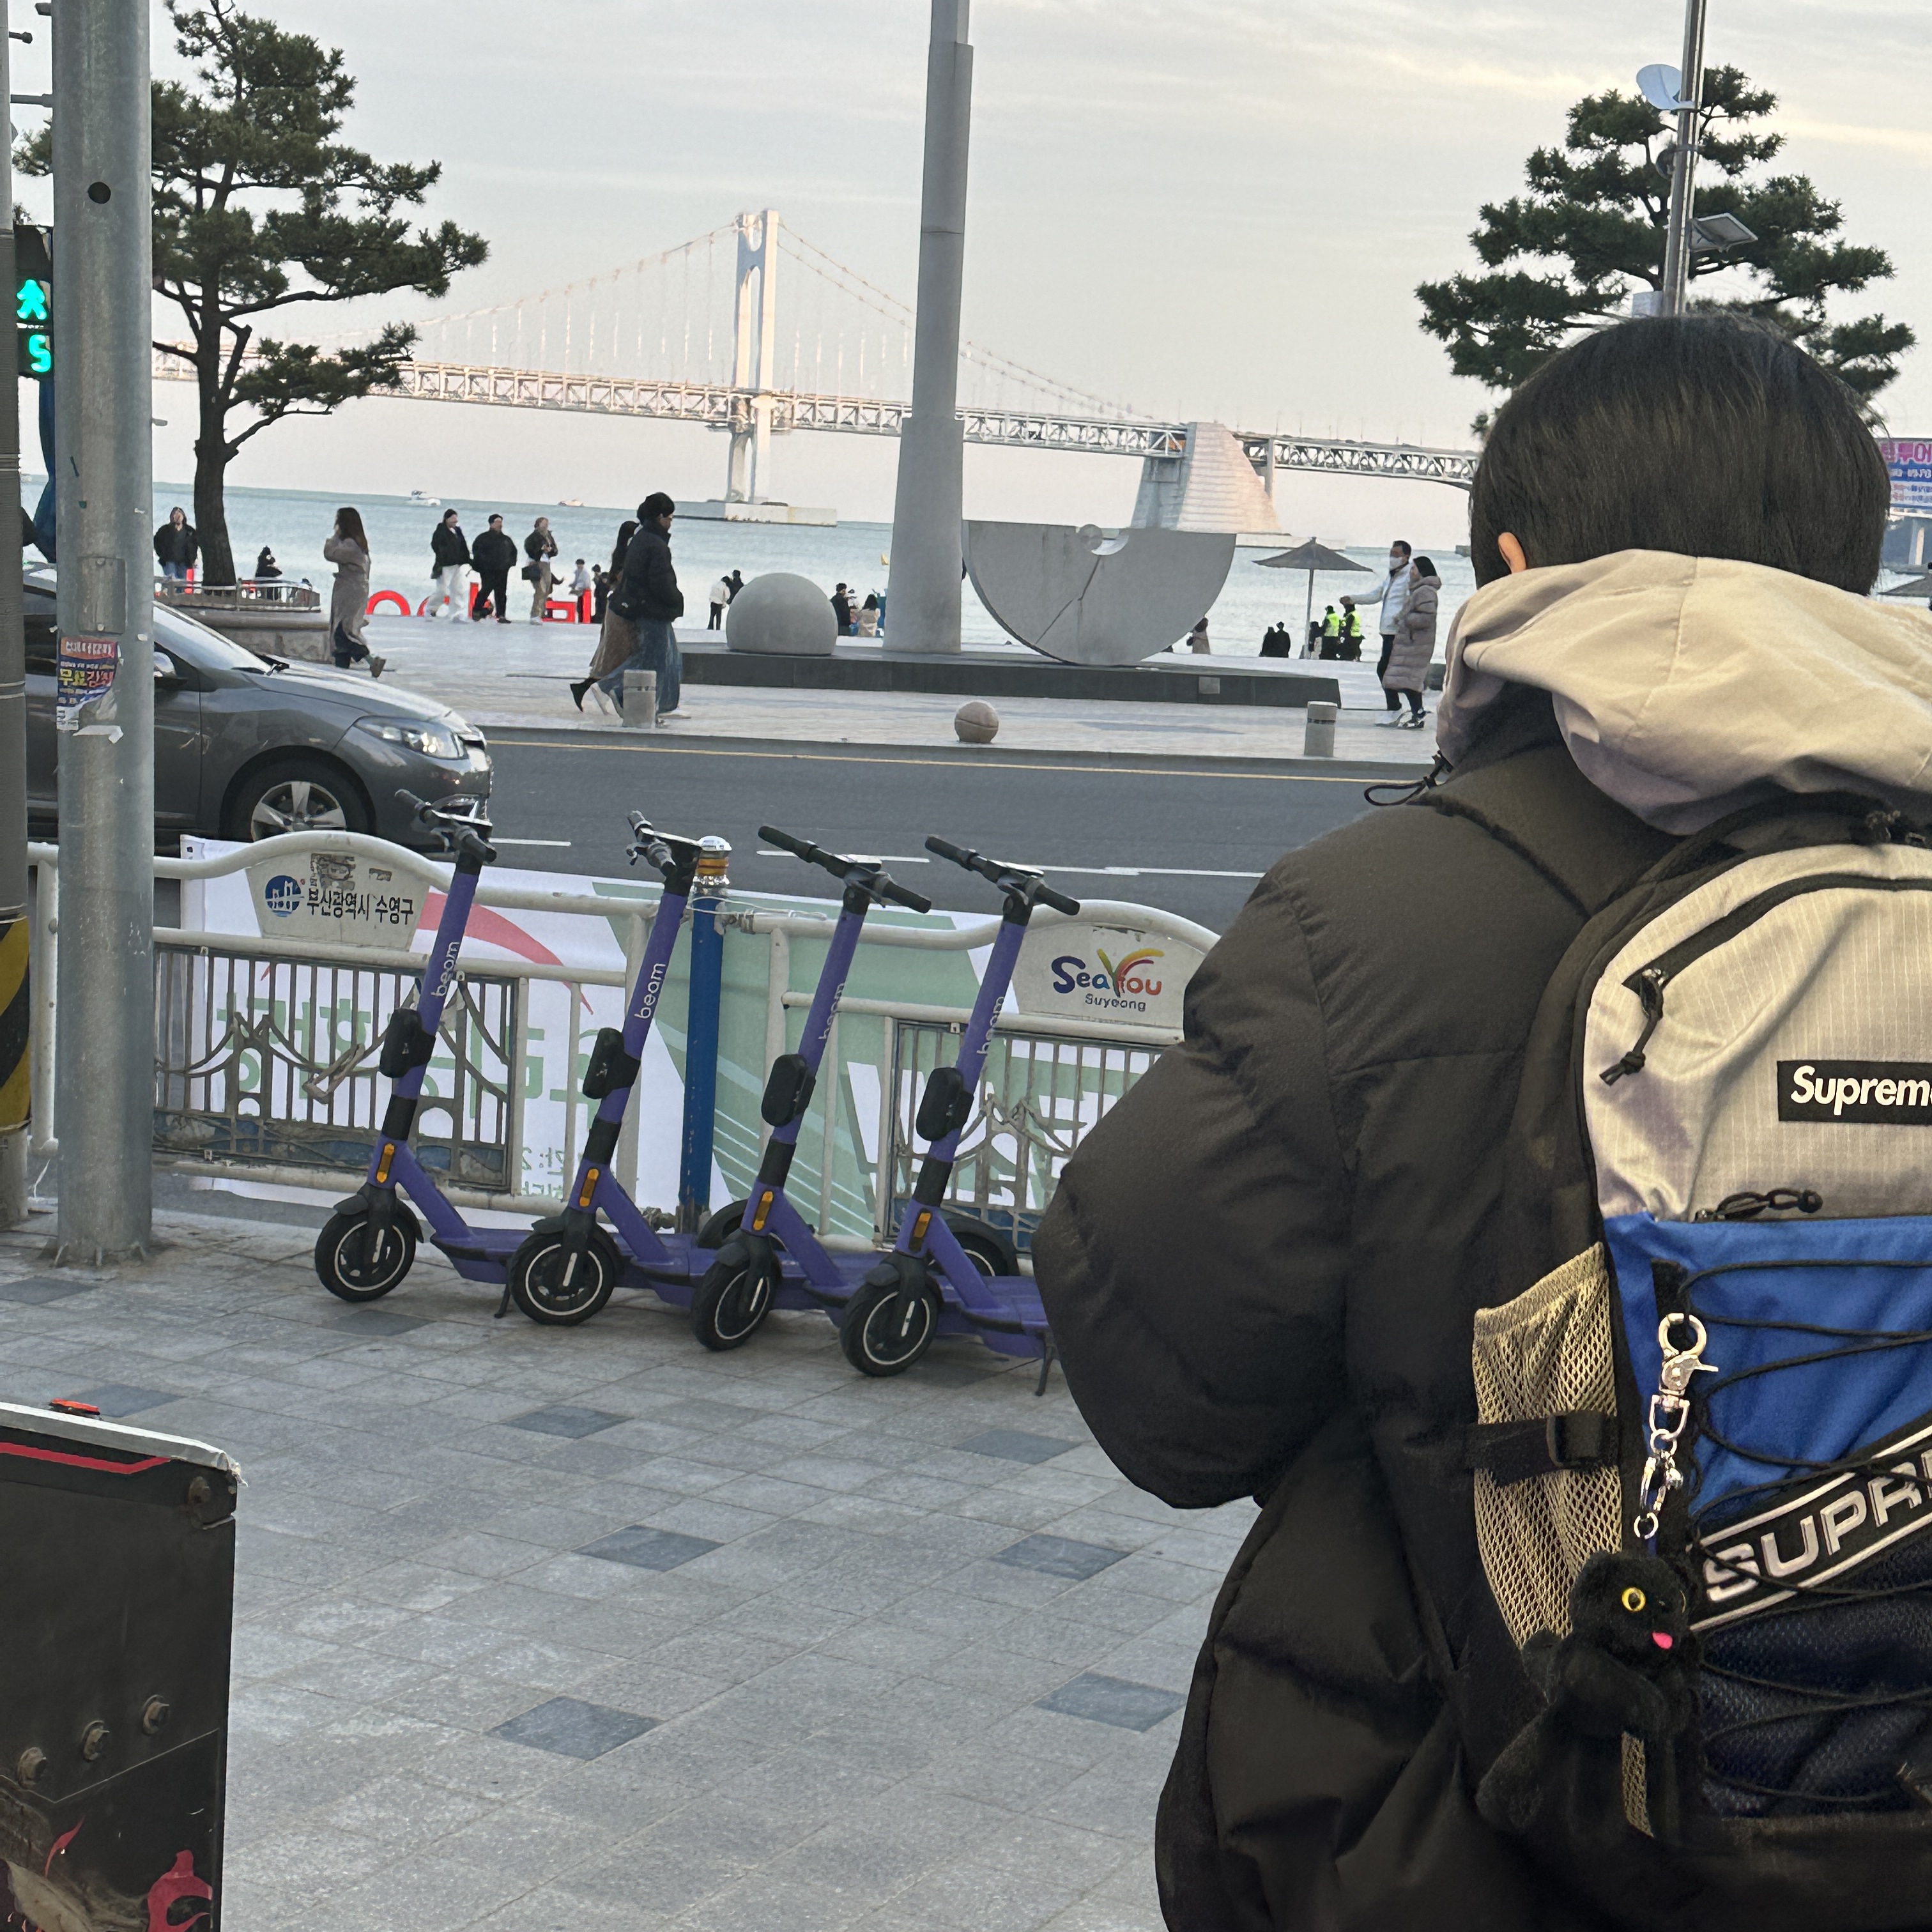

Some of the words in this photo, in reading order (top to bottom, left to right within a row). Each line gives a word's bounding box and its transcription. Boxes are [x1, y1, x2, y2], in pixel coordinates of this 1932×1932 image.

[29, 334, 51, 372] 5
[307, 887, 371, 921] 부산광역시
[374, 895, 414, 925] 수영구
[431, 942, 461, 997] beam
[634, 963, 666, 1018] beam
[1085, 993, 1146, 1012] Suyeong
[1791, 1065, 1932, 1116] Suprem
